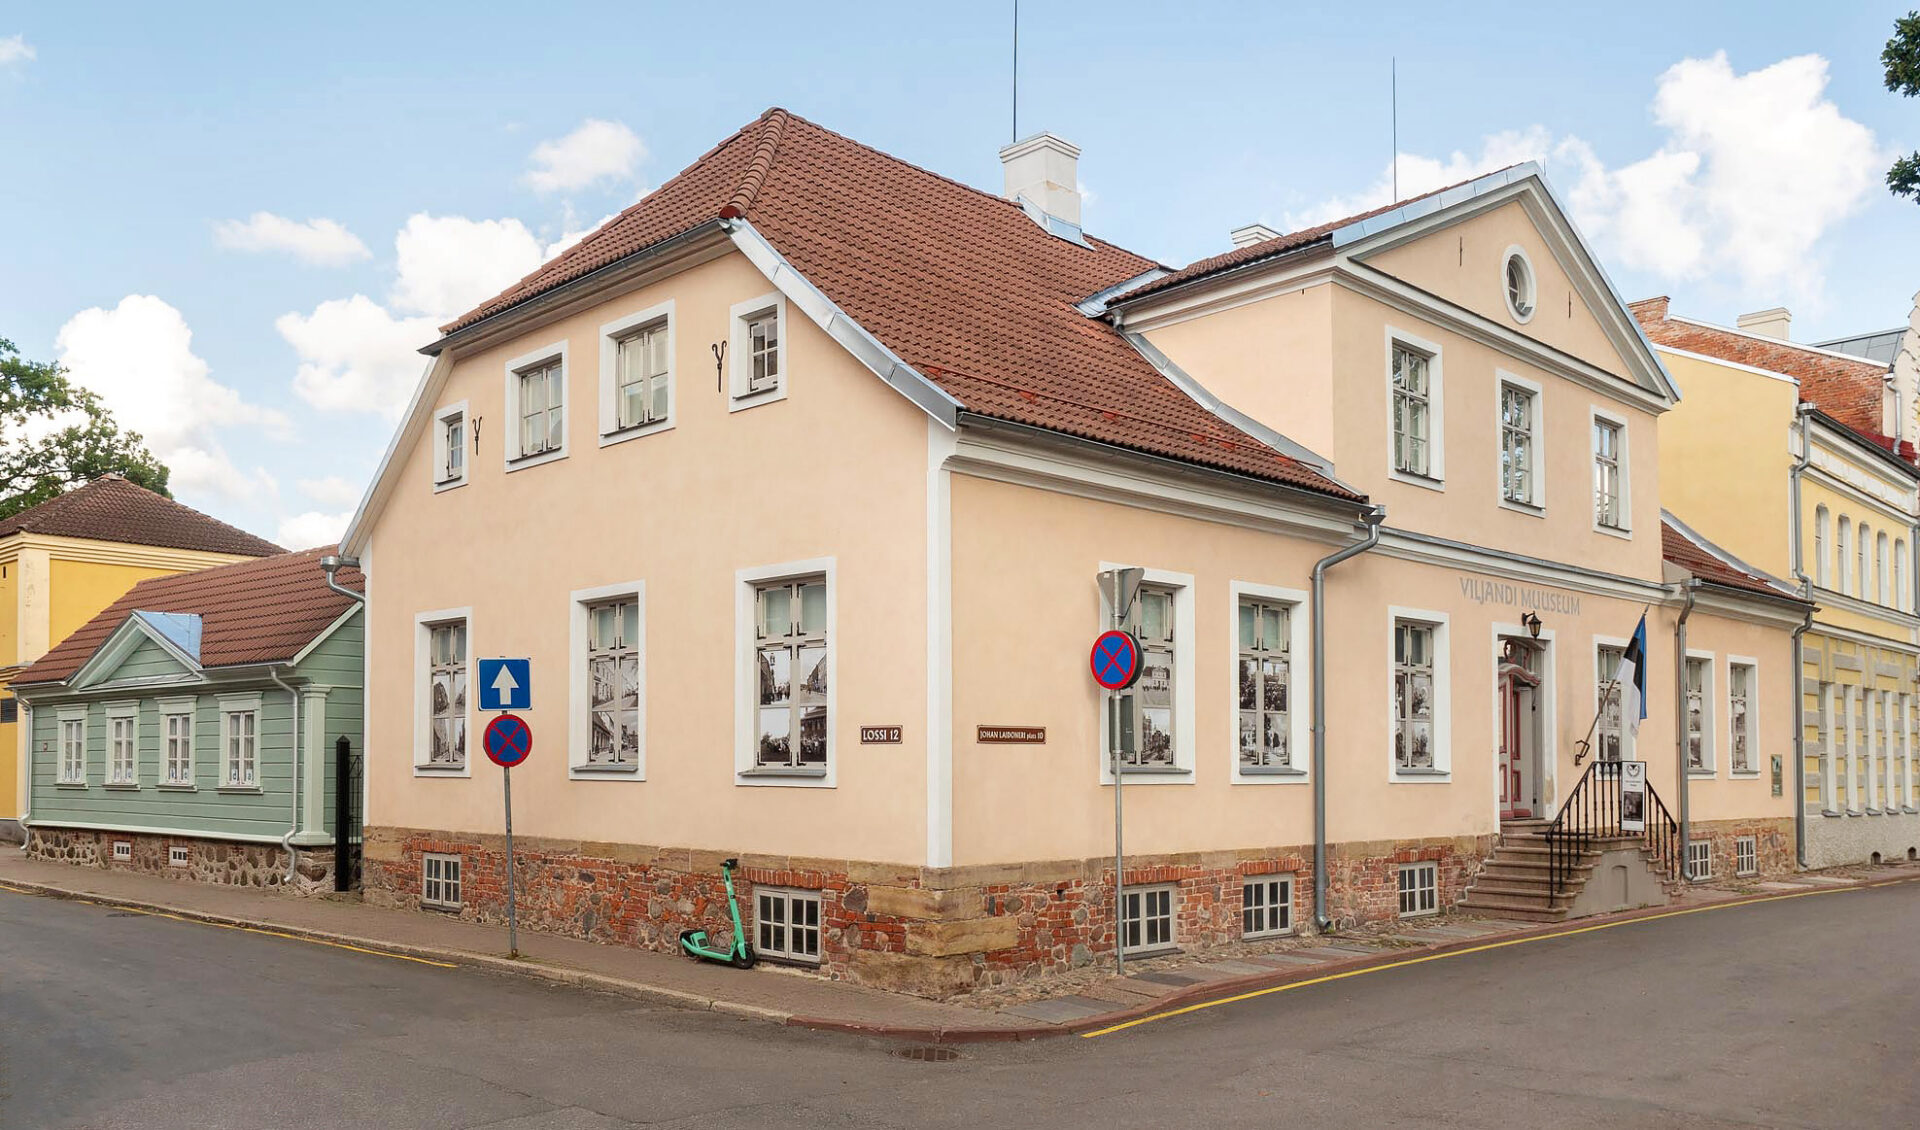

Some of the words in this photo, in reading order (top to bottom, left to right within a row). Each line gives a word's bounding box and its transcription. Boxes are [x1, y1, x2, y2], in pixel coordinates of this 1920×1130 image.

[1459, 577, 1517, 606] VILJANDI
[1521, 588, 1581, 616] MUUSEUM
[863, 729, 887, 740] LOSSI
[890, 729, 899, 740] 12
[980, 730, 998, 739] JOHAN
